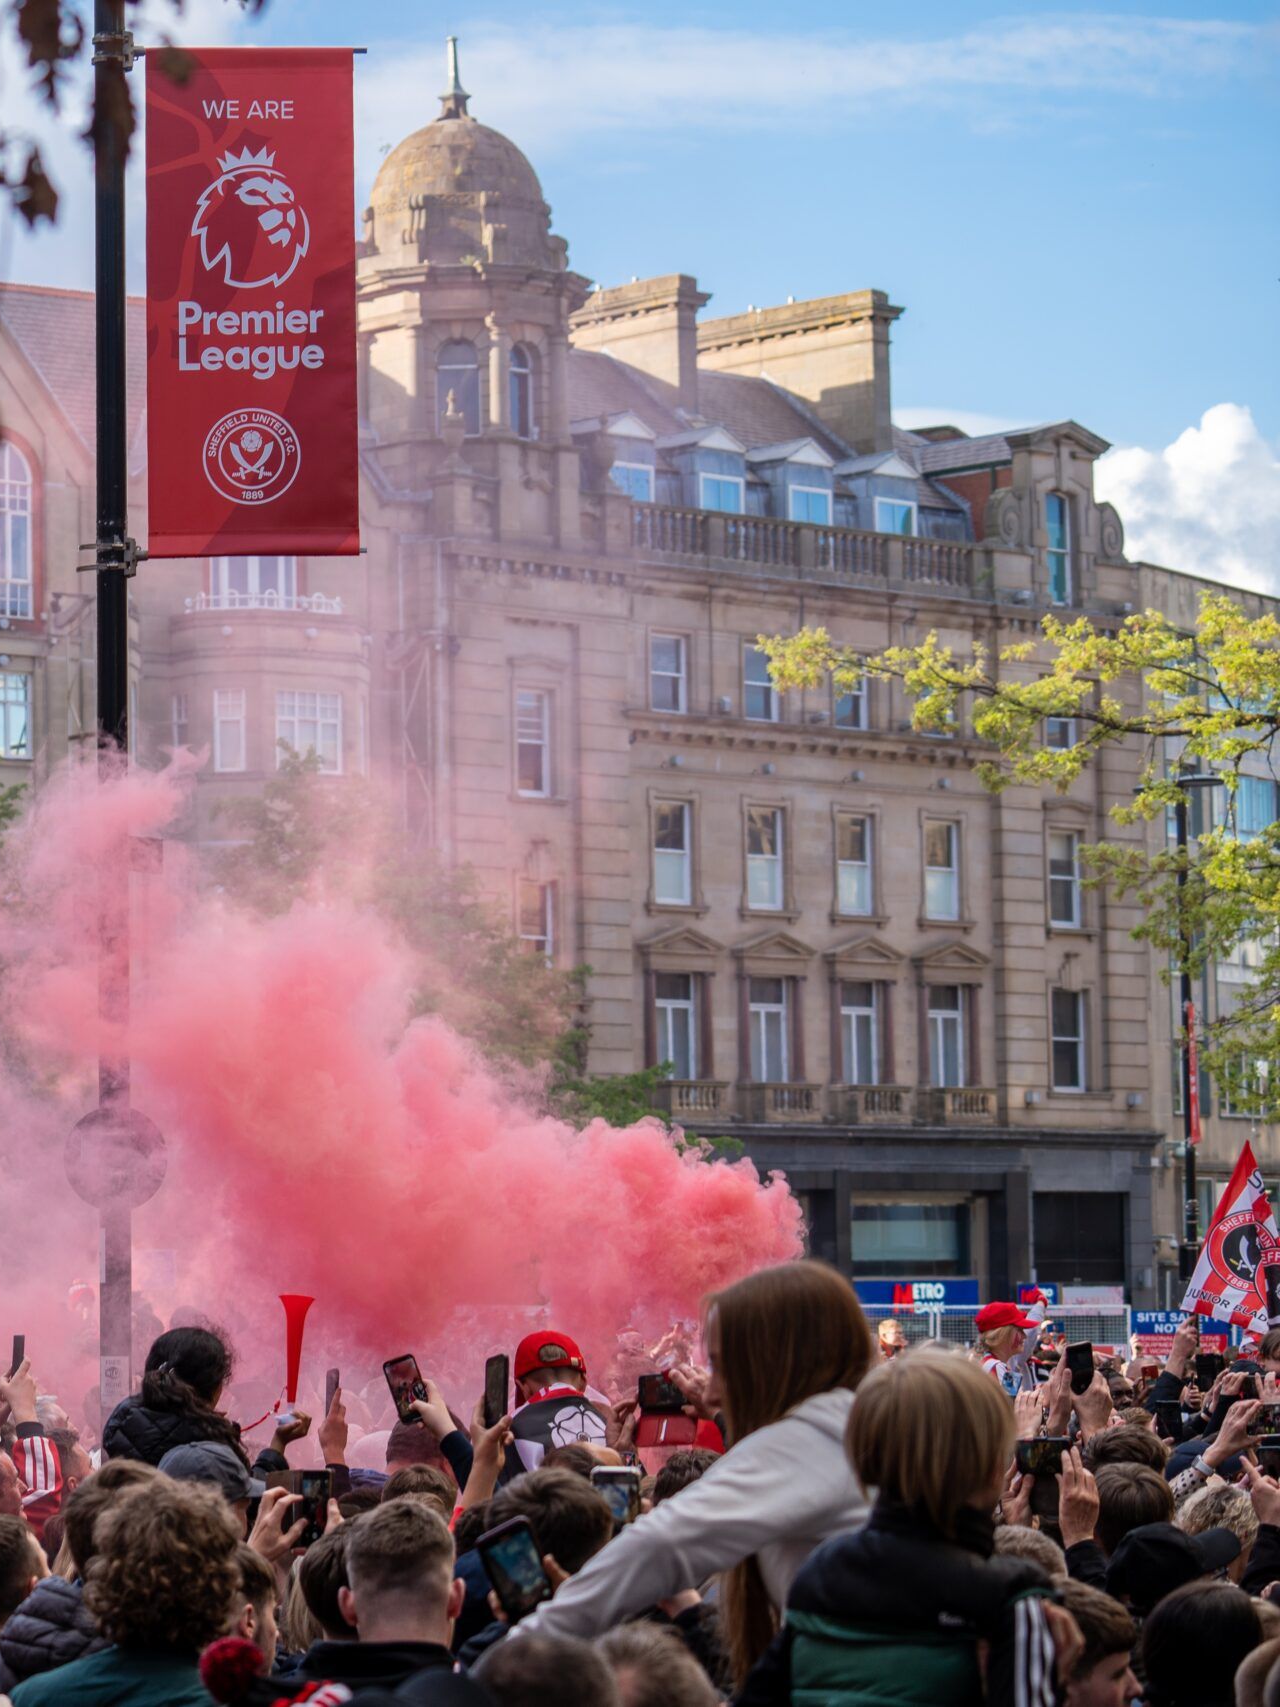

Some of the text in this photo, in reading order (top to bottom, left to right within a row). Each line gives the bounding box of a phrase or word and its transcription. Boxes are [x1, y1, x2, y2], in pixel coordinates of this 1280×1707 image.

[202, 100, 294, 119] WE ARE
[178, 301, 324, 335] Premier
[178, 336, 324, 380] League
[208, 413, 248, 457] SHEFFIELD
[252, 413, 287, 436] UNITED
[241, 490, 264, 500] 1889
[1219, 1212, 1255, 1232] SHEFFI
[1226, 1273, 1250, 1289] 1889
[893, 1283, 945, 1313] METRO
[1186, 1287, 1268, 1322] JUNIOR BLAD
[1136, 1312, 1166, 1323] SITE
